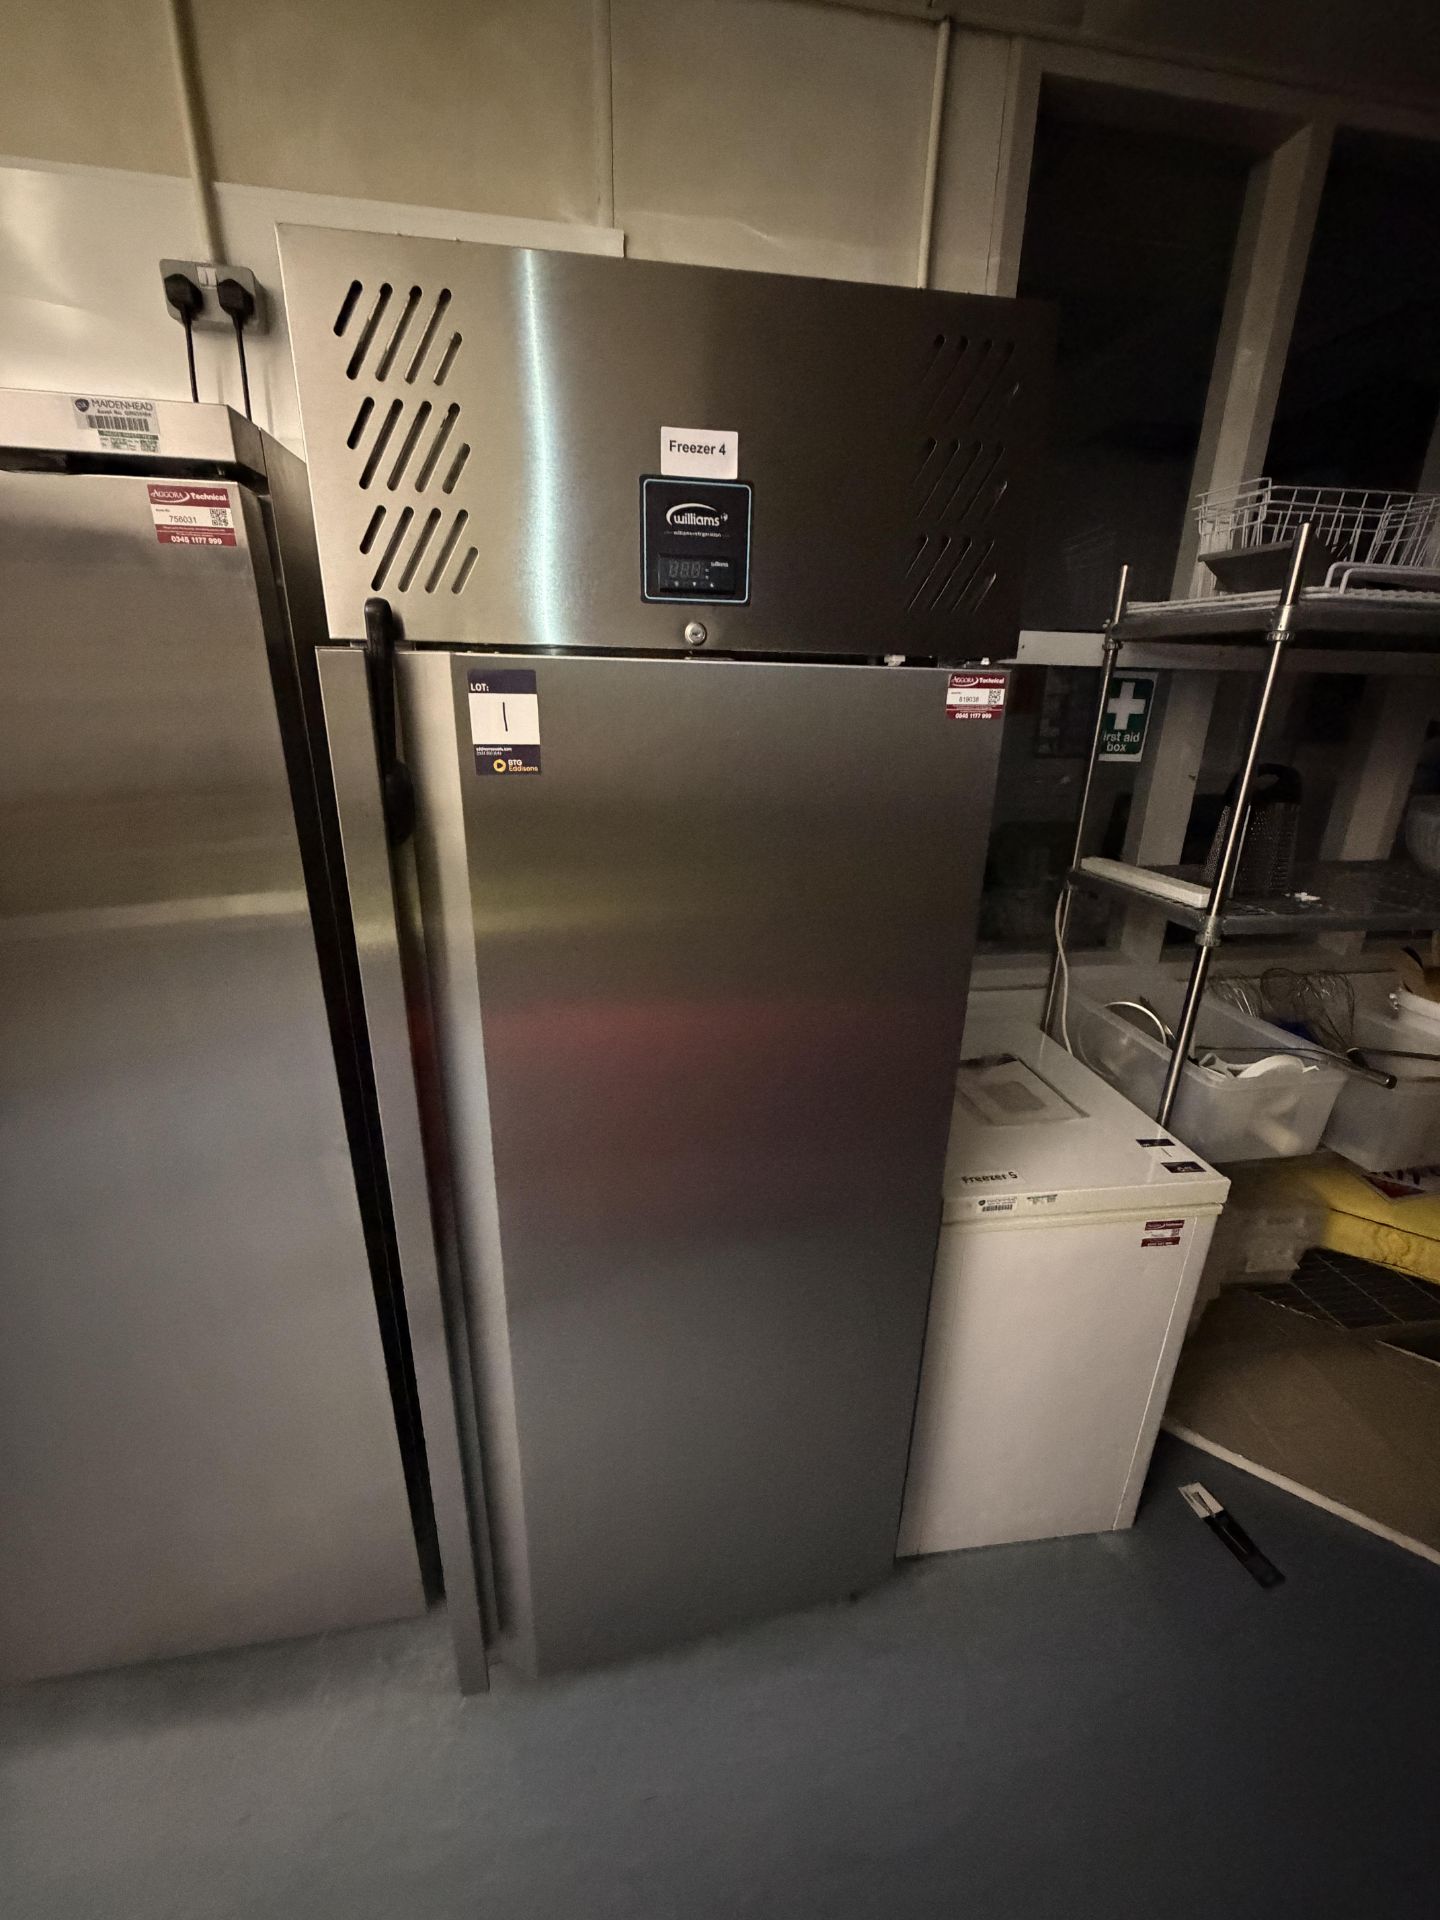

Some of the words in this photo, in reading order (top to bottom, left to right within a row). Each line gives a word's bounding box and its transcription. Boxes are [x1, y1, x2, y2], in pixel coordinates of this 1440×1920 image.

[91, 399, 153, 411] MAIDENHEAD
[669, 439, 716, 455] Freezer
[718, 443, 726, 456] 4
[190, 492, 227, 501] Technical
[673, 512, 720, 527] williams
[191, 536, 207, 544] 1177
[470, 683, 490, 692] LOT:
[1102, 731, 1122, 742] irst
[1123, 732, 1140, 743] aid
[1106, 742, 1127, 752] box
[961, 1174, 1007, 1184] Freezer
